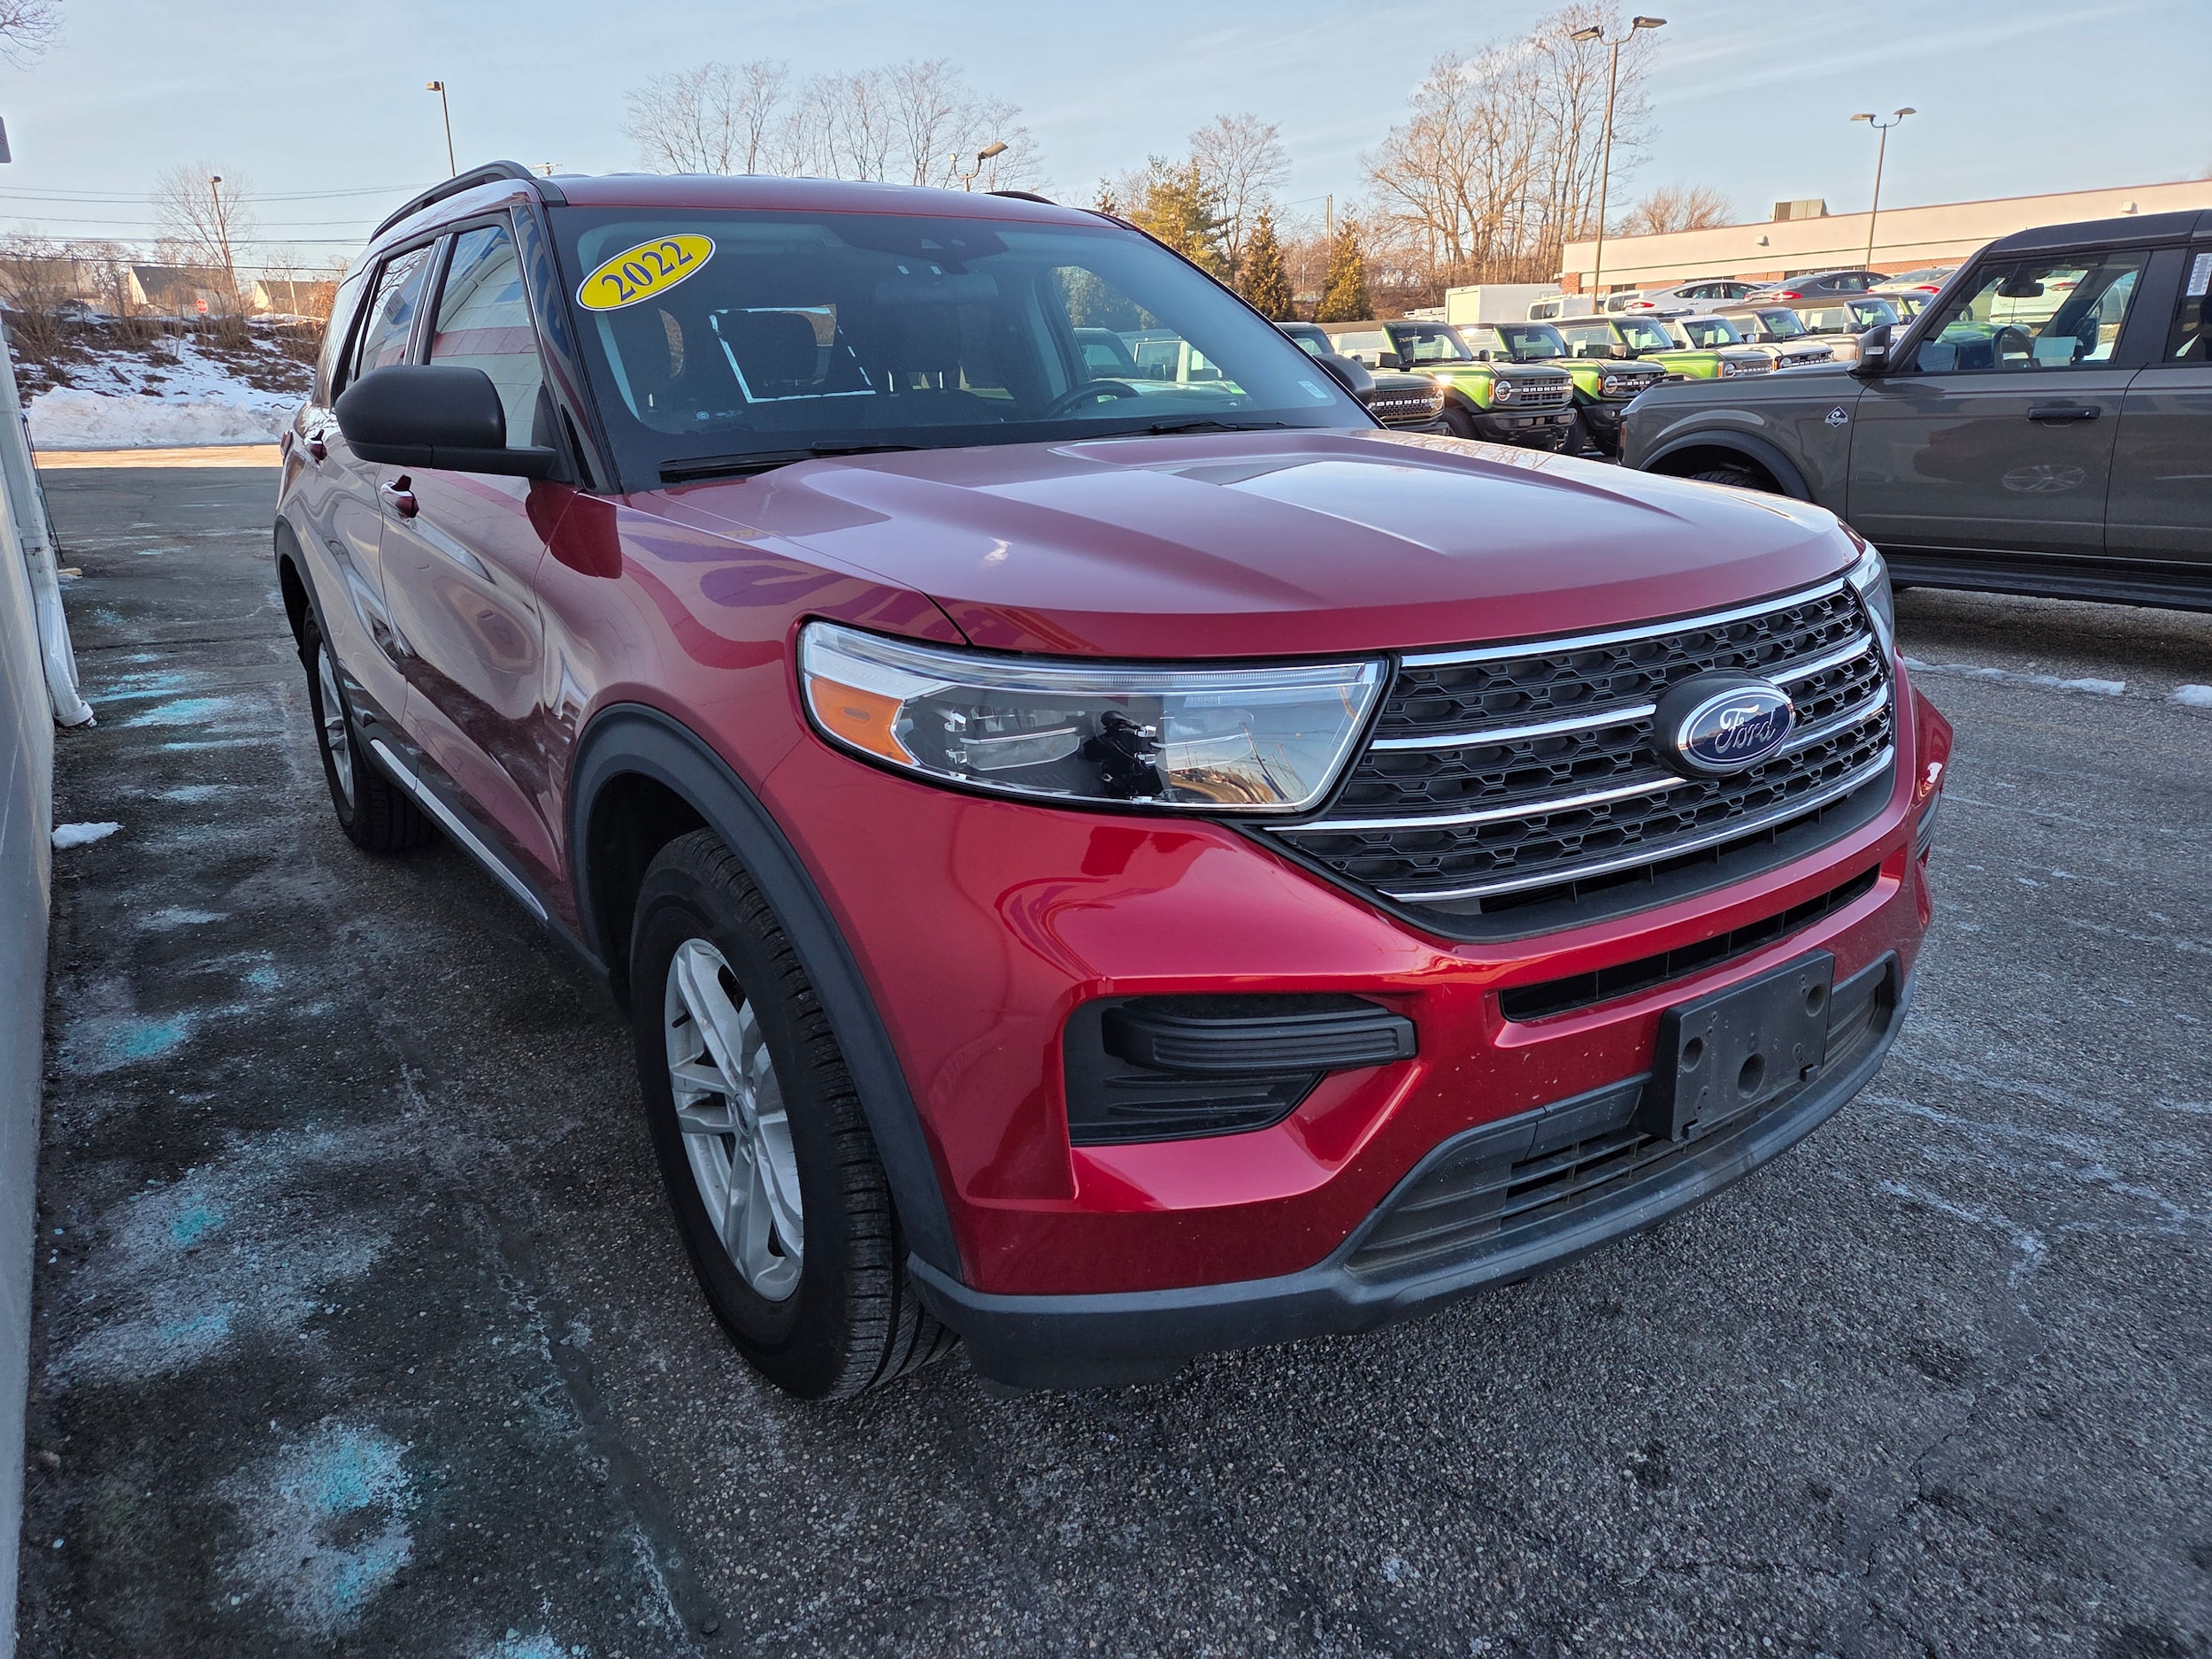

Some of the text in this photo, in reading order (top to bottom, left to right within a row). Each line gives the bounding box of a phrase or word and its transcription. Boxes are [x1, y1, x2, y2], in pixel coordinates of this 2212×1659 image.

[601, 242, 694, 302] 2022
[1376, 398, 1428, 407] BRONCO
[1714, 703, 1777, 754] Ford
